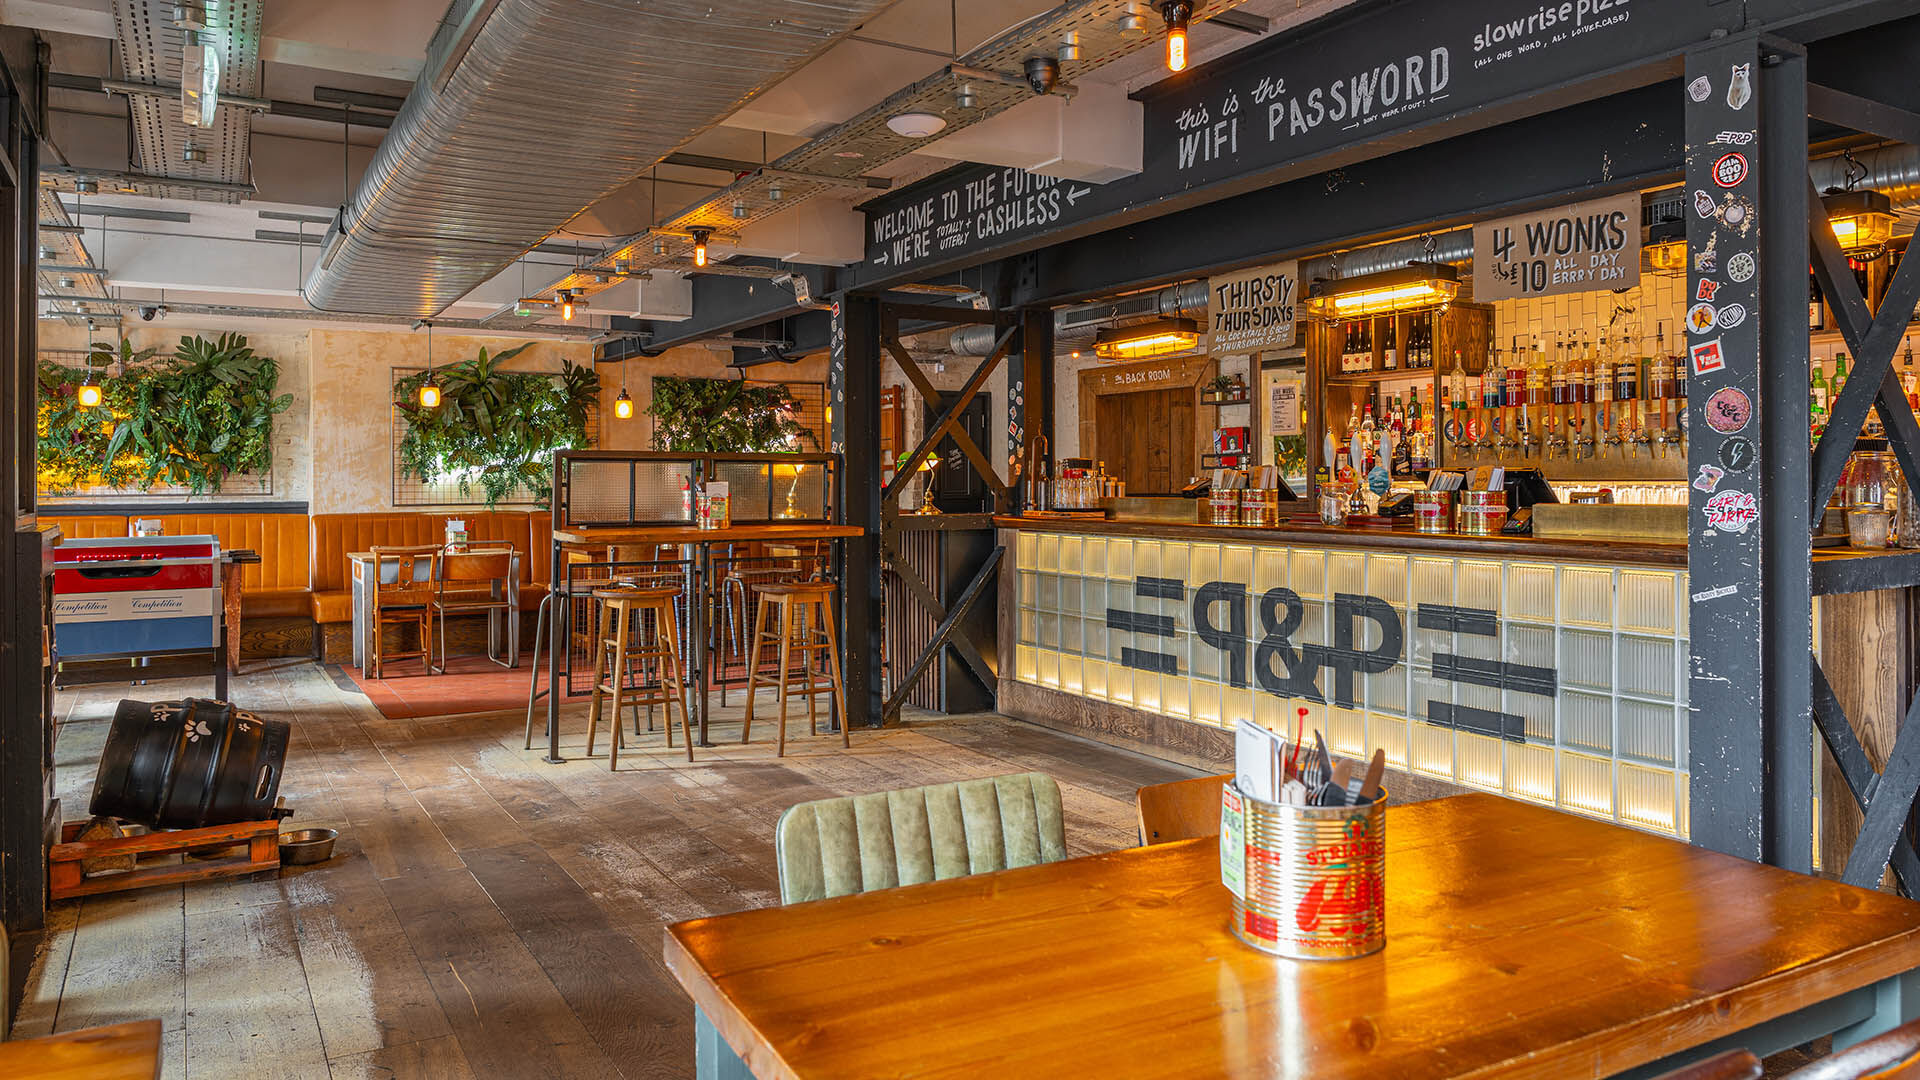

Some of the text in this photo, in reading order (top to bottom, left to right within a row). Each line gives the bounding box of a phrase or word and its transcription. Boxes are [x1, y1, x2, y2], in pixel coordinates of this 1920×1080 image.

[1496, 50, 1513, 61] ONE
[1552, 32, 1567, 44] ALL
[1176, 77, 1287, 131] this is the
[1178, 46, 1449, 170] WIFI PASSWORD
[873, 168, 1064, 243] WELCOME TO THE FUTU
[976, 188, 1060, 240] CASHLESS
[893, 231, 930, 266] WE'RE
[936, 220, 964, 238] TOTALLY
[939, 232, 970, 251] UTTERLY
[1493, 210, 1628, 264] 4 WONKS
[1554, 257, 1578, 271] ALL
[1590, 253, 1620, 268] DAY
[1600, 266, 1626, 281] DAY
[1216, 274, 1294, 312] THIRSTY
[1216, 305, 1294, 332] THURSDAYS
[1222, 337, 1264, 352] THURSDAYS
[1125, 371, 1146, 384] BACK
[1148, 368, 1171, 382] ROOM
[56, 599, 183, 613] Competition Competition
